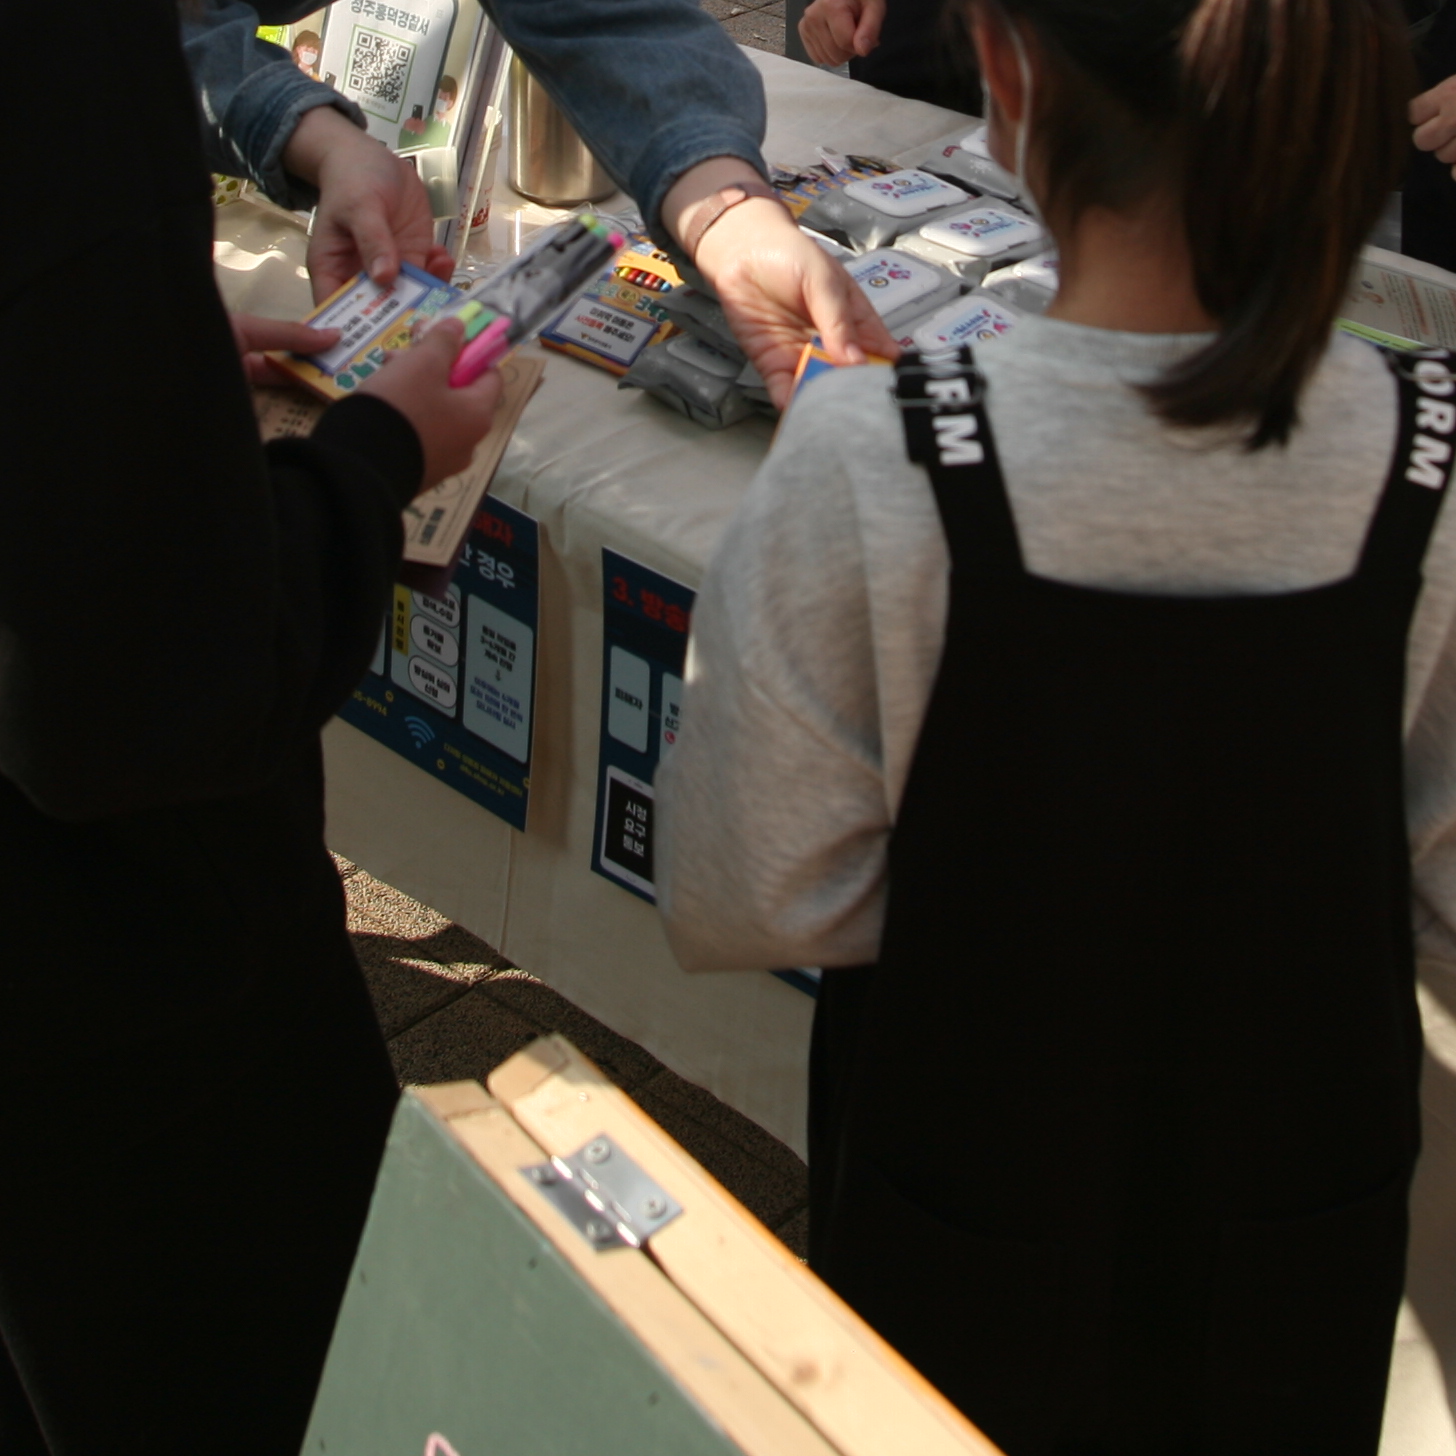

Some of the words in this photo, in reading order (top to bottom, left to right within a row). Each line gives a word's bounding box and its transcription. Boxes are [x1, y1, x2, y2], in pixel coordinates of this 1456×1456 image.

[477, 548, 516, 589] 경우
[612, 575, 634, 607] 3.
[623, 817, 646, 838] 요구
